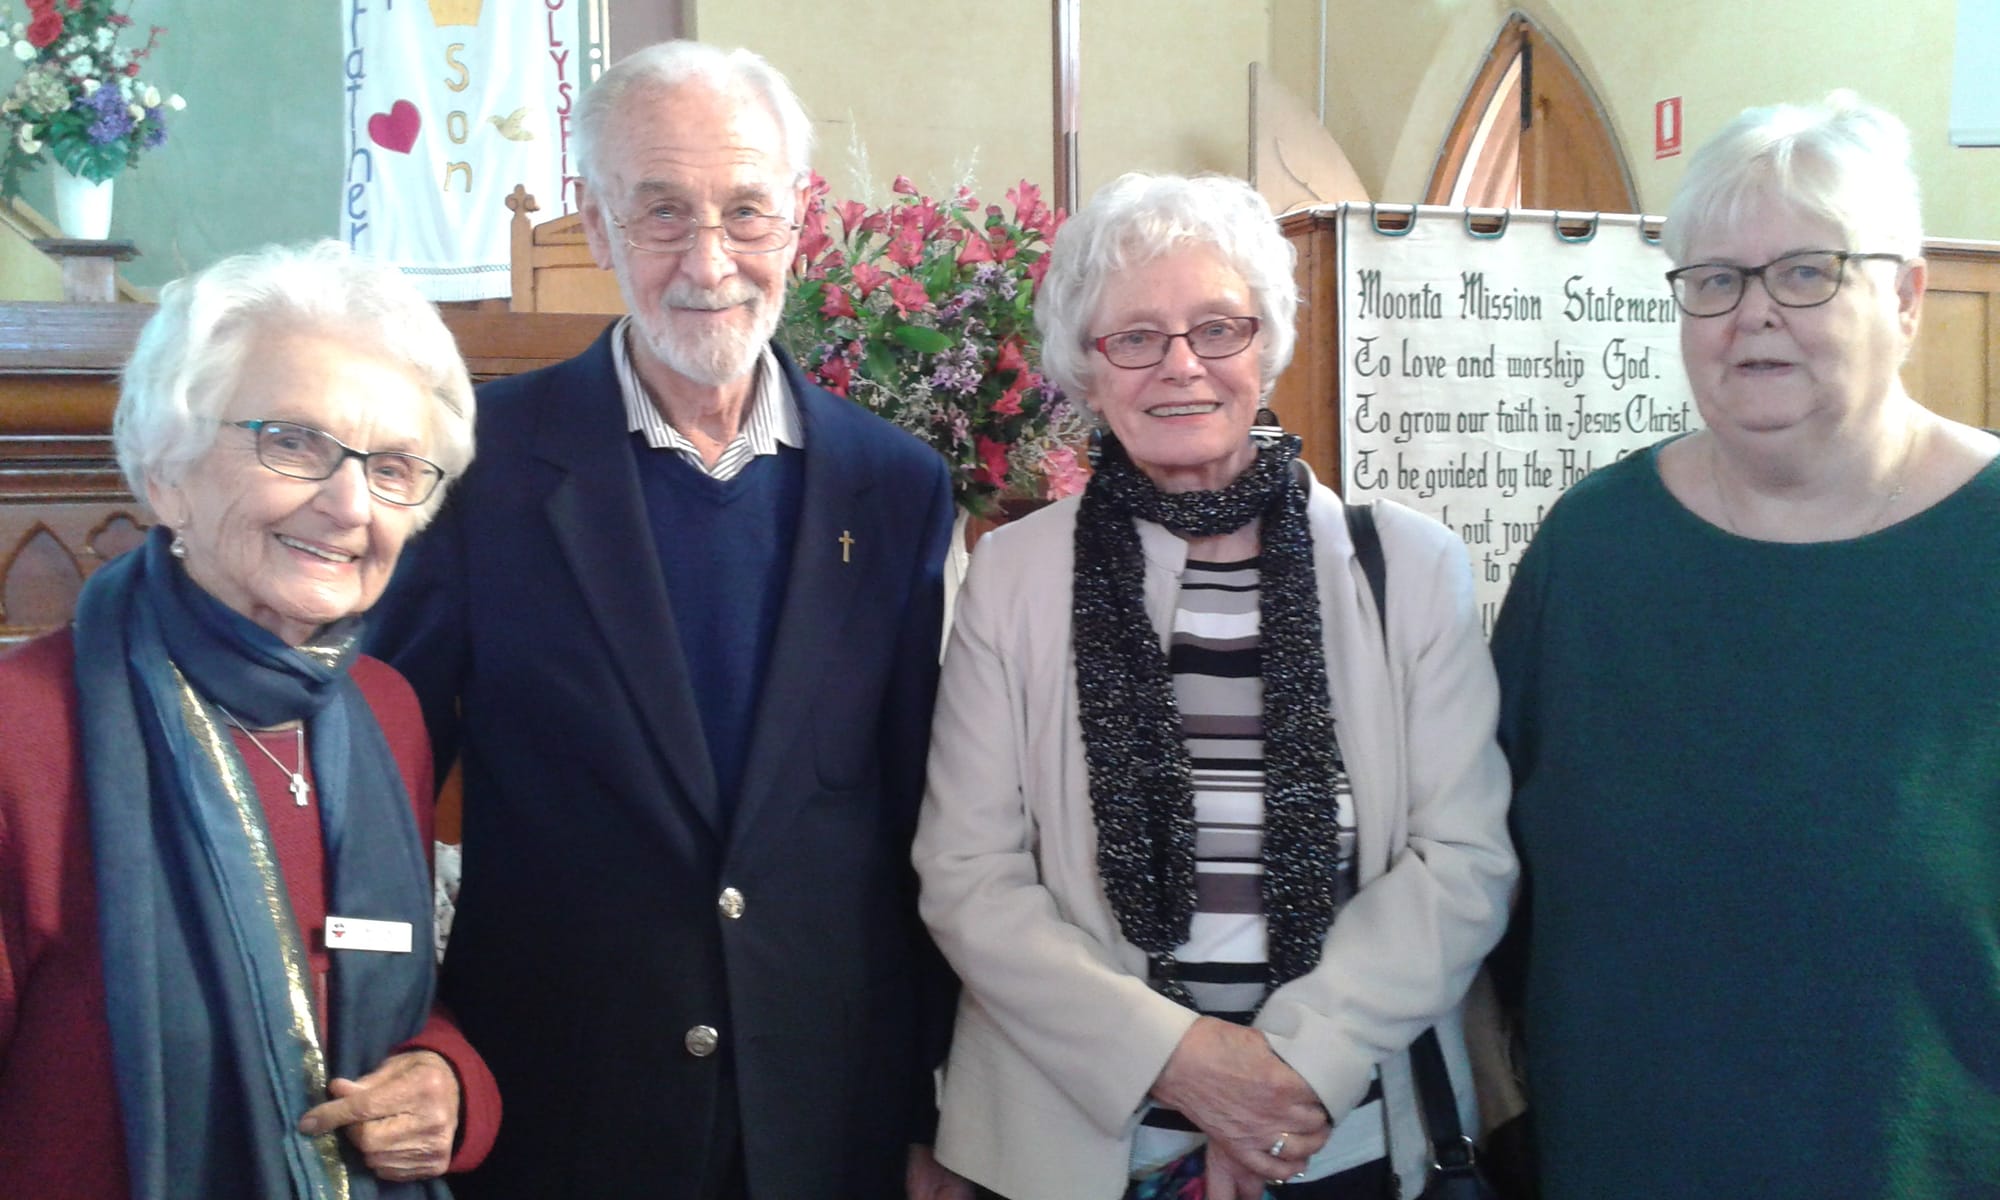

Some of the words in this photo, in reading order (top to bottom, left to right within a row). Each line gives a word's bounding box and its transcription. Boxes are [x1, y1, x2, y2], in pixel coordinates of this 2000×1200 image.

[444, 43, 472, 193] Son
[1357, 269, 1442, 319] Moonta
[1459, 271, 1542, 320] Mission
[1563, 275, 1676, 322] Statement
[1355, 336, 1390, 377] To
[1457, 344, 1496, 378] and
[1507, 339, 1584, 388] worship
[1602, 338, 1660, 391] God.
[1356, 392, 1390, 433] To
[1393, 411, 1450, 443] grow
[1457, 411, 1490, 433] our
[1496, 398, 1538, 433] faith
[1545, 405, 1562, 433] in
[1567, 394, 1621, 440] Jesus
[1354, 449, 1388, 490] To
[1398, 452, 1419, 489] be
[1418, 451, 1488, 498] guided
[1496, 451, 1518, 498] by
[1523, 449, 1553, 488] the
[1462, 508, 1493, 544] out
[1482, 552, 1500, 582] to
